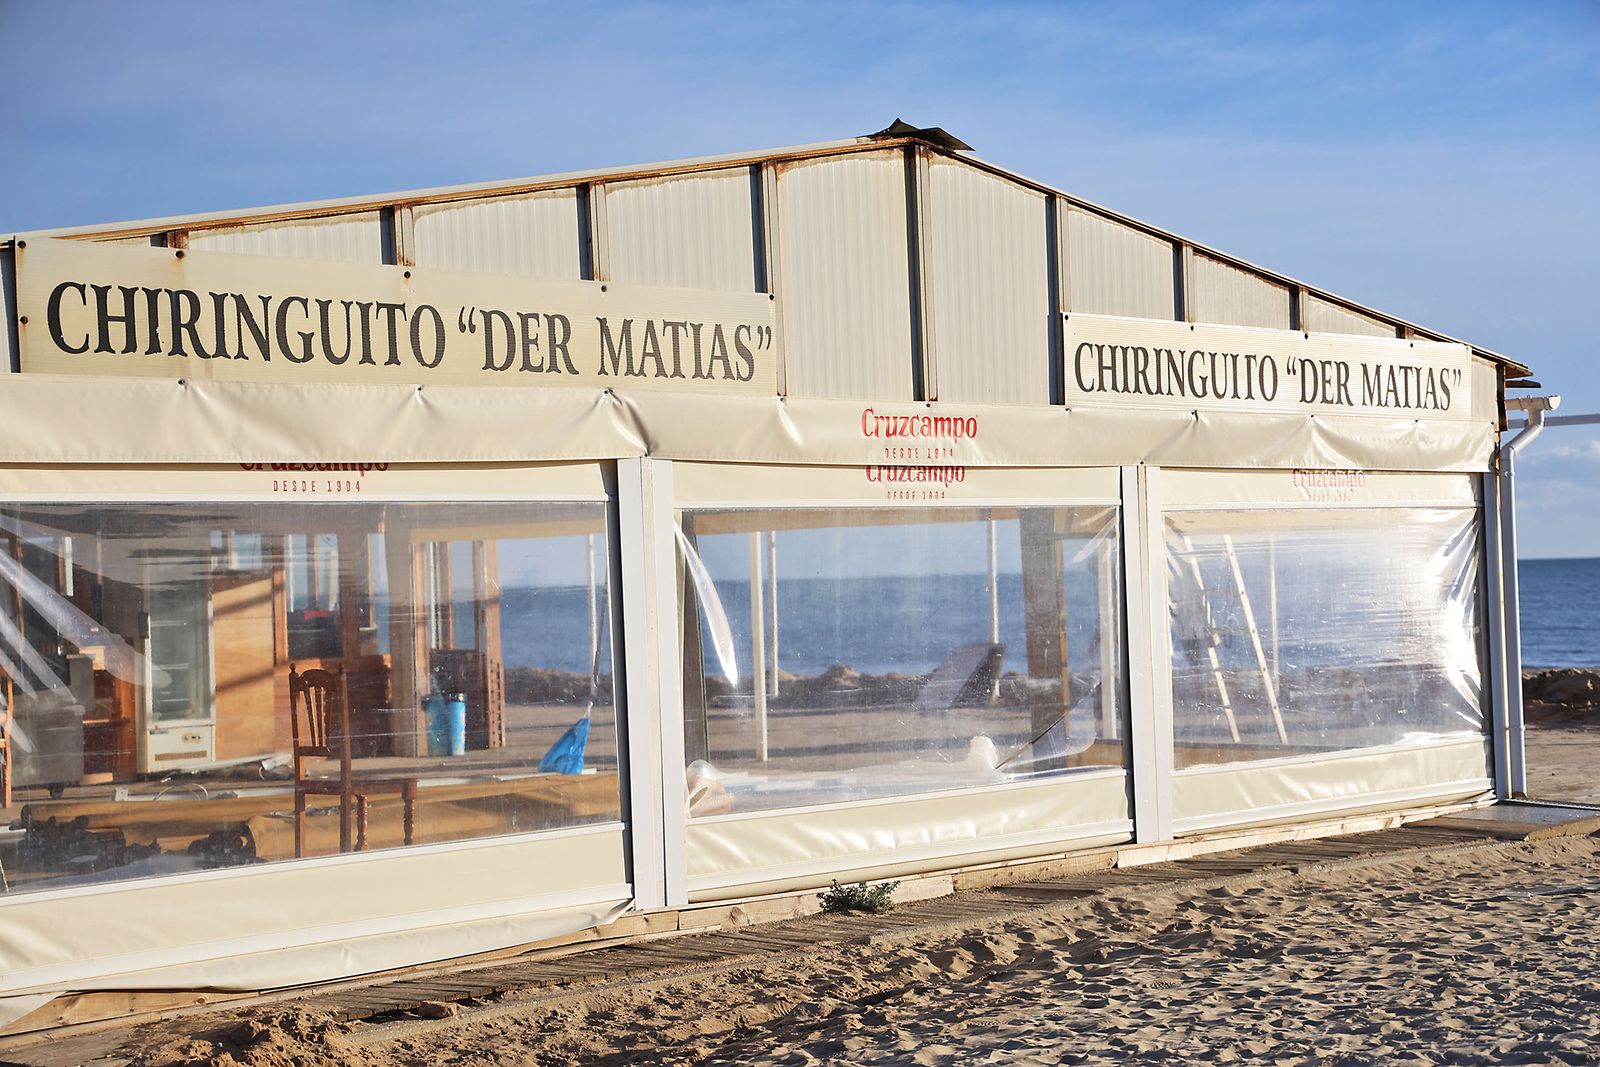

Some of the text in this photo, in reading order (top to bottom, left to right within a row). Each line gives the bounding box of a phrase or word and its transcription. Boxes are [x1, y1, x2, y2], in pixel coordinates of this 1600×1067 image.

[47, 281, 445, 369] CHIRINGUITO
[1074, 341, 1278, 402] CHIRINGUITO
[861, 406, 978, 444] Cruzcampo
[885, 447, 953, 459] DESDE 1904
[273, 480, 361, 492] DESDE 1904
